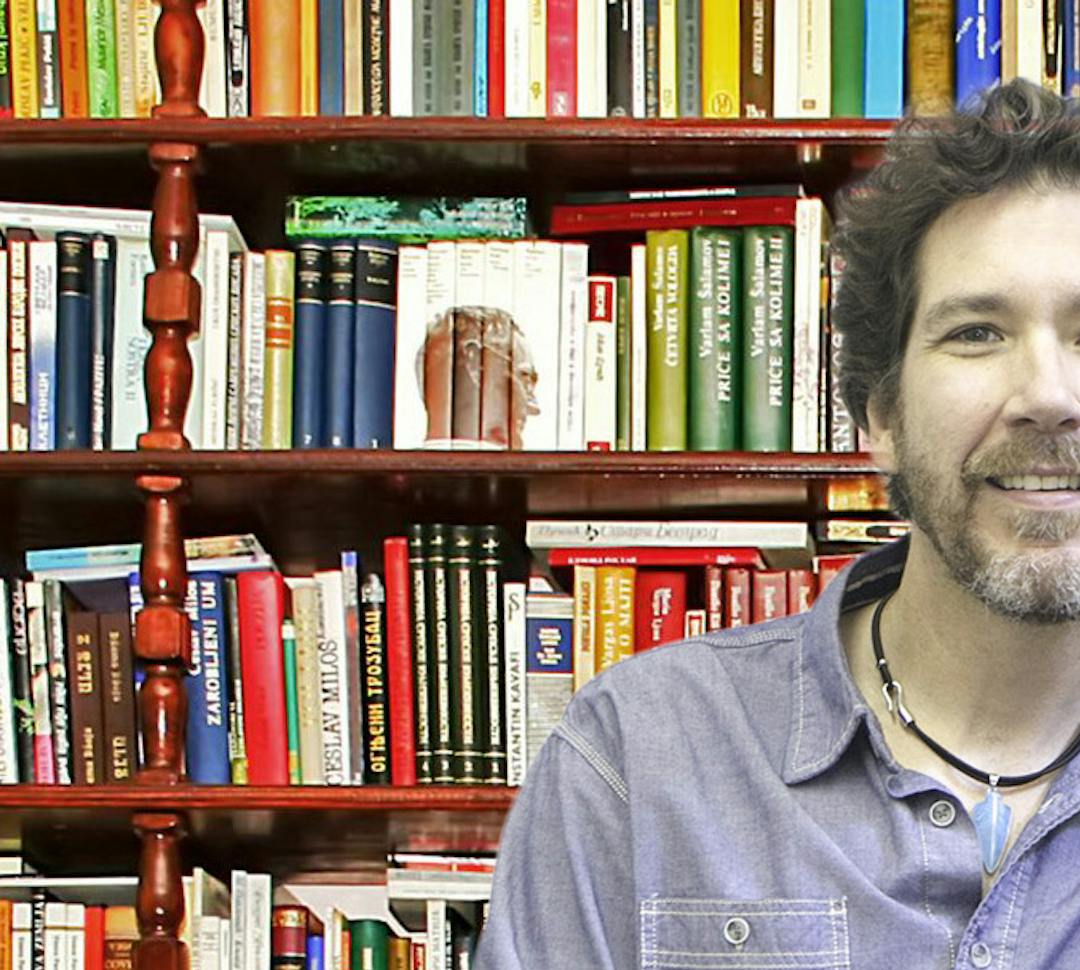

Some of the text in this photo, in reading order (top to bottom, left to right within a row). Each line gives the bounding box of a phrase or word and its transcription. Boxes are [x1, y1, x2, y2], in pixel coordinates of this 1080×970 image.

[697, 239, 712, 357] Varlam Šalamov
[717, 250, 730, 316] KOLIME
[750, 236, 765, 358] Varlam Šalamov
[717, 322, 730, 344] SA
[769, 326, 782, 347] SA
[201, 581, 222, 726] ZAROBLJENI UM
[363, 609, 384, 698] ТРОЗУБАЦ
[509, 651, 521, 704] KAVAFI
